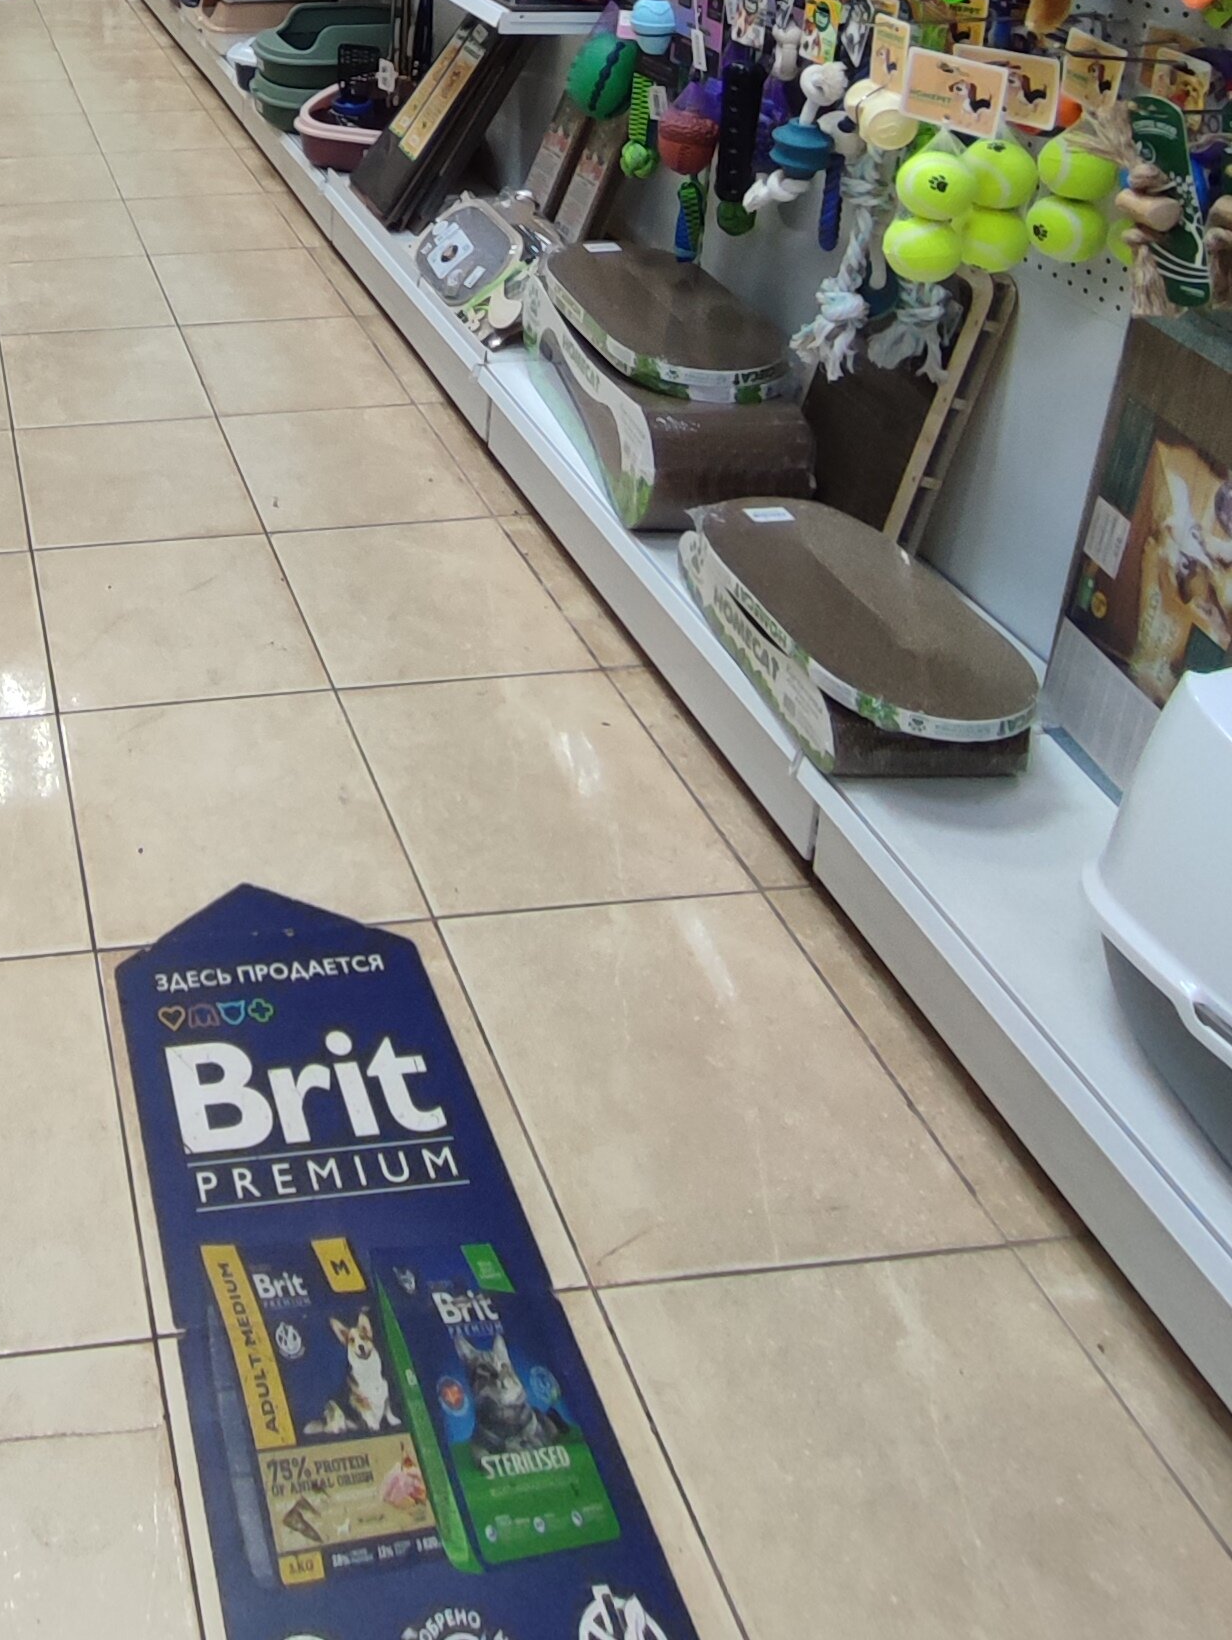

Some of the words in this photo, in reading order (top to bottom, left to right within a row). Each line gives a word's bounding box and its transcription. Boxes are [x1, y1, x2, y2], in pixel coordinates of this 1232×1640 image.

[714, 586, 780, 681] HOMECAT
[155, 968, 232, 993] ЗДЕСЬ
[236, 954, 385, 984] ПРОДАЕТСЯ
[165, 1030, 447, 1155] Brit
[196, 1146, 459, 1204] PREMIUM
[252, 1271, 309, 1300] Brit
[330, 1259, 351, 1276] M
[217, 1262, 260, 1348] MEDIUM
[431, 1290, 500, 1325] Brit
[247, 1354, 280, 1434] ADULT
[267, 1455, 312, 1483] 75%
[313, 1453, 370, 1475] PROTEIN
[480, 1445, 571, 1480] STERILISED
[271, 1484, 286, 1497] OF
[290, 1477, 336, 1495] ANIMAL
